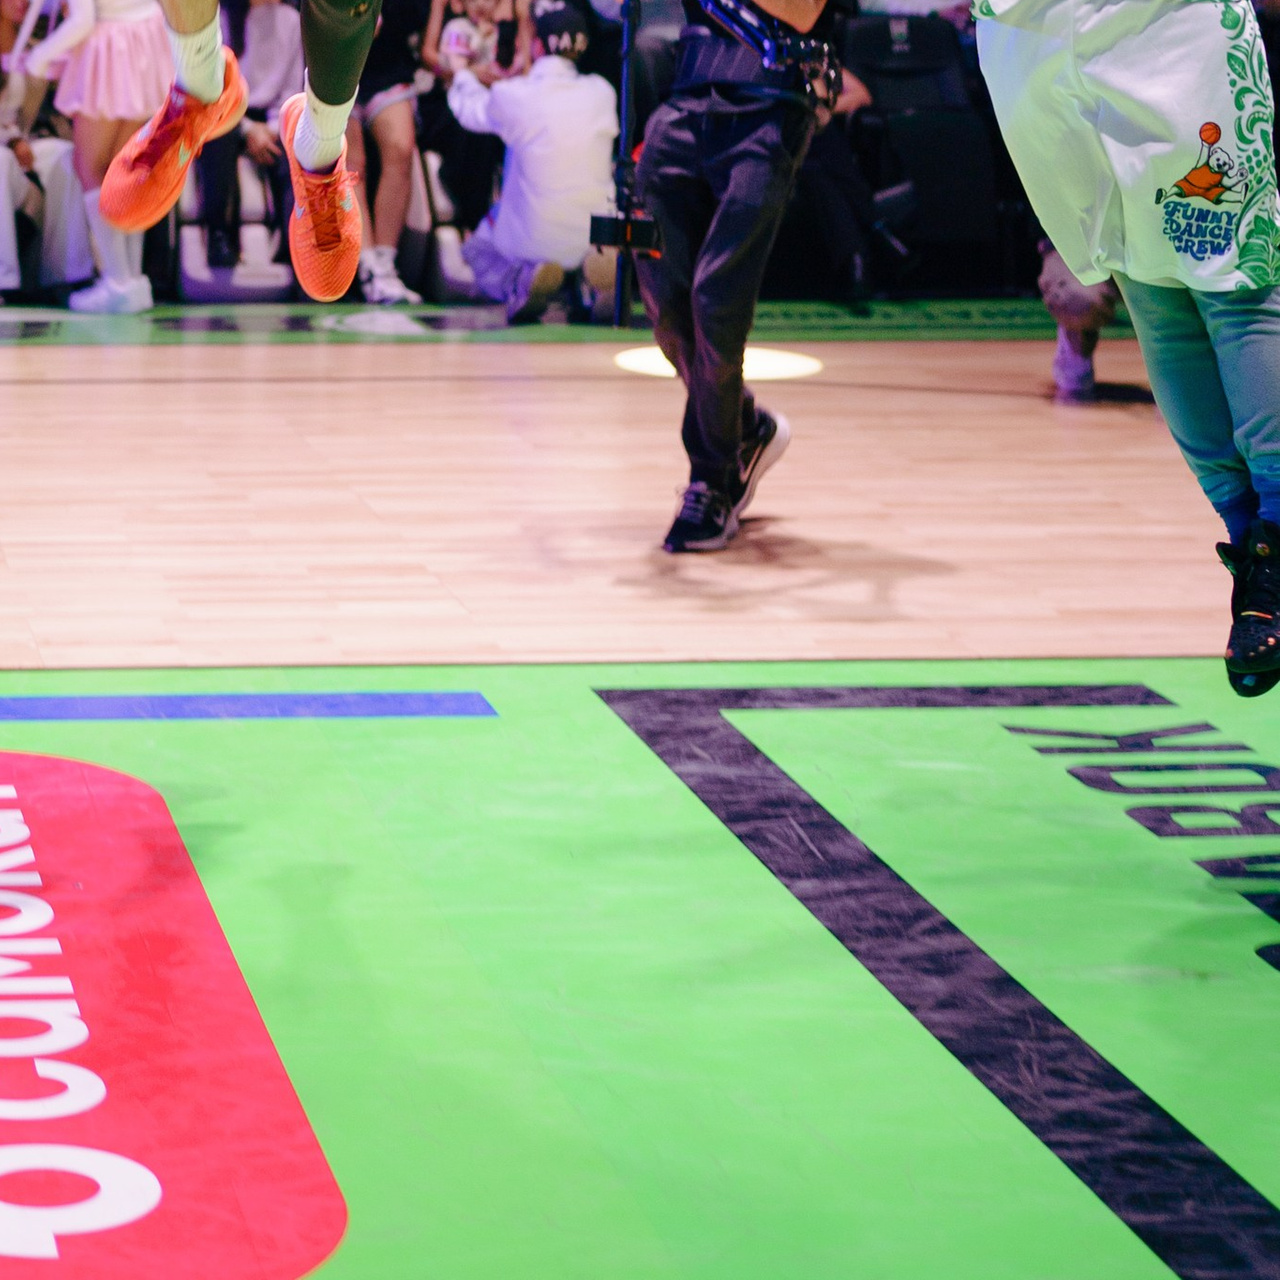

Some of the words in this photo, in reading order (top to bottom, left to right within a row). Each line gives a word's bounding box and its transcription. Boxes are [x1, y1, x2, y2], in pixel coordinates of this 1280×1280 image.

[1163, 200, 1238, 227] FUNNY
[1163, 216, 1233, 240] DANCE
[1168, 234, 1232, 261] CREW
